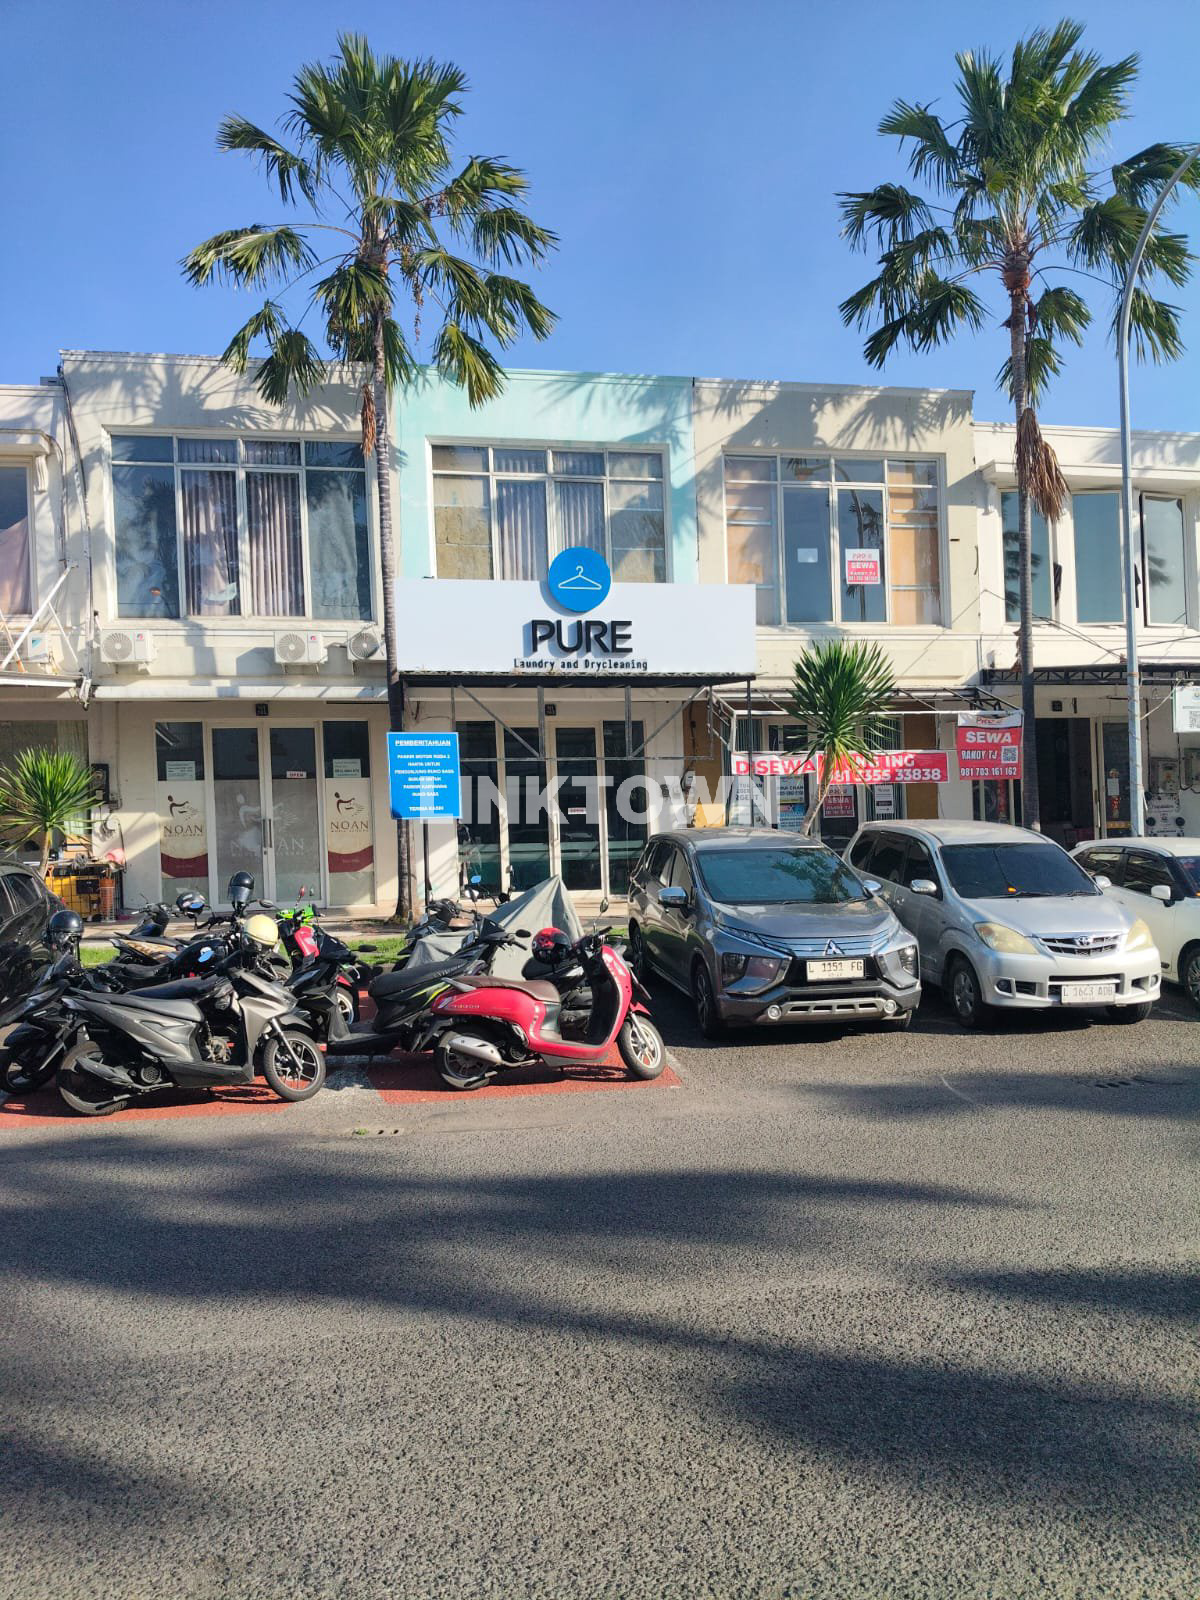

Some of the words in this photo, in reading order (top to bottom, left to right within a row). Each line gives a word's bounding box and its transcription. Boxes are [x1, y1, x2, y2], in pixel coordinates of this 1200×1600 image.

[531, 620, 633, 653] PURE
[513, 658, 555, 671] Laundry
[560, 659, 579, 669] and
[584, 658, 648, 671] Drycleaning
[966, 731, 1012, 743] SEWA
[886, 754, 915, 767] ING
[988, 750, 999, 760] TJ
[895, 768, 941, 781] 33838
[960, 767, 974, 777] 081
[164, 824, 203, 834] NOAN
[330, 820, 369, 830] NOAN
[808, 962, 815, 973] L
[822, 961, 844, 972] 1151
[851, 960, 863, 971] FG
[1063, 987, 1069, 997] L
